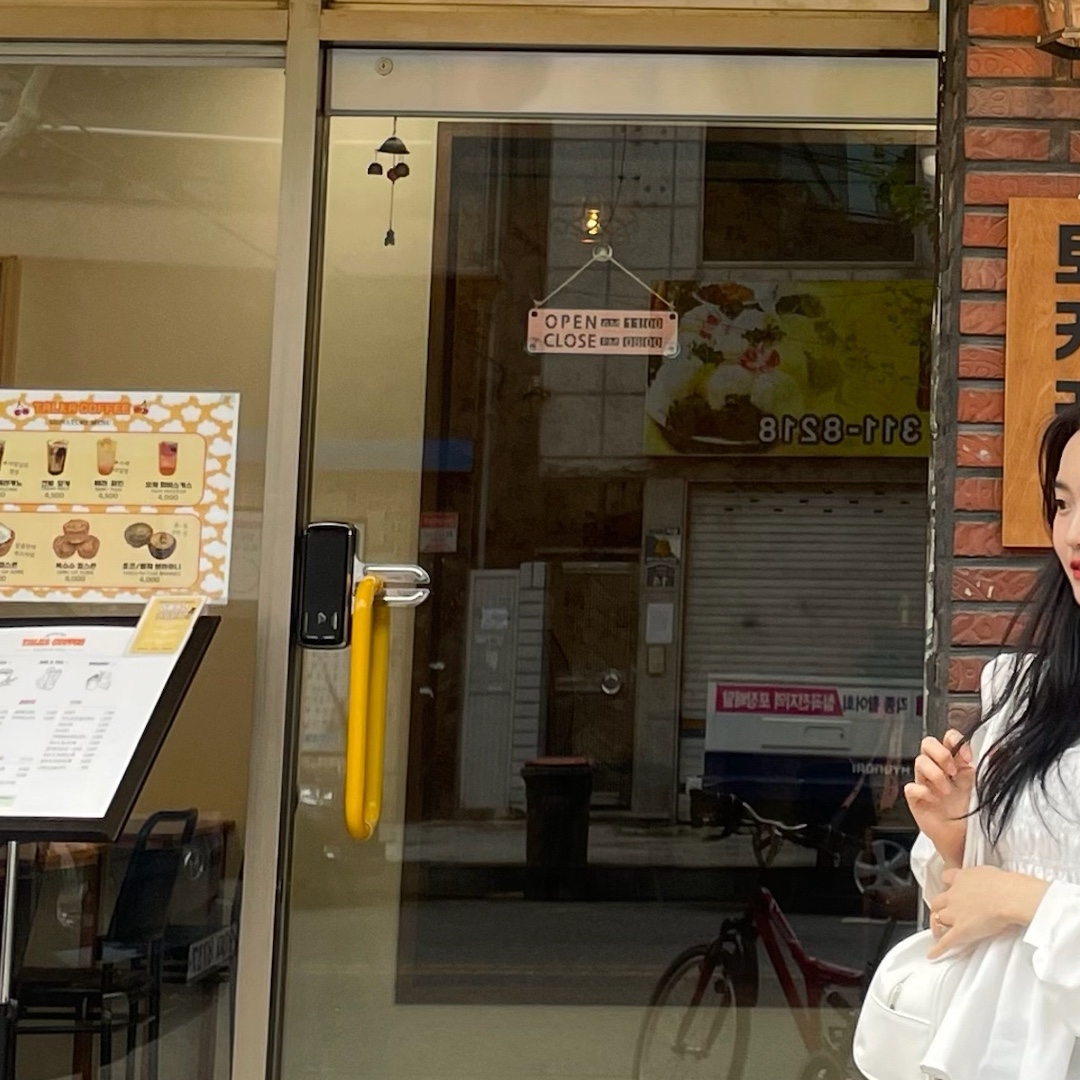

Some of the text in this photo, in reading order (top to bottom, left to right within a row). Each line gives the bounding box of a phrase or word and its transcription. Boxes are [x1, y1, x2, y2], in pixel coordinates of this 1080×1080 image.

[545, 313, 597, 330] OPEN
[543, 332, 597, 349] CLOSE
[79, 401, 130, 415] COFFEE
